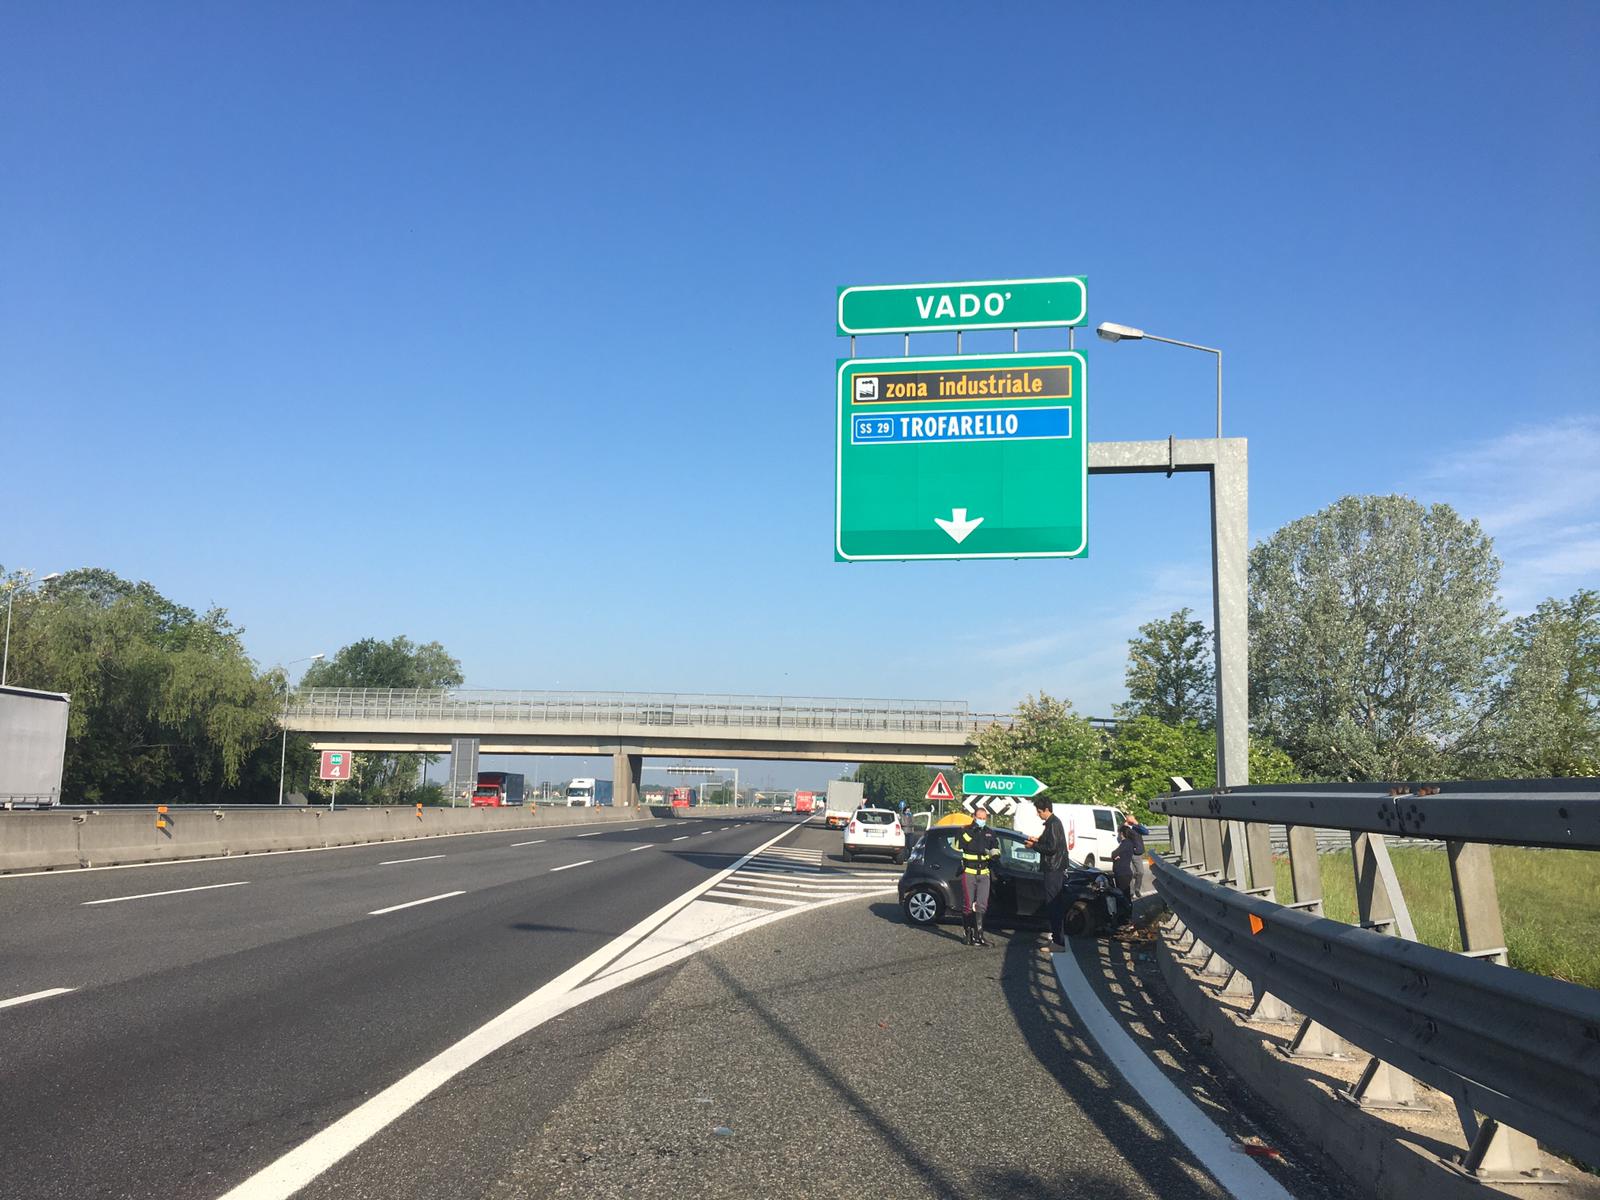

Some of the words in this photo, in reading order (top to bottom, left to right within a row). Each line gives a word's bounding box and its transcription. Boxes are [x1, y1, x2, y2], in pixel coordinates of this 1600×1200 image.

[915, 292, 1011, 318] VADO'
[886, 380, 928, 397] zona
[939, 373, 1043, 396] industriale
[859, 422, 872, 434] SS
[877, 421, 890, 434] 29
[900, 414, 1018, 437] TROFARELLO
[330, 766, 340, 777] 4
[984, 780, 1014, 790] VADO'
